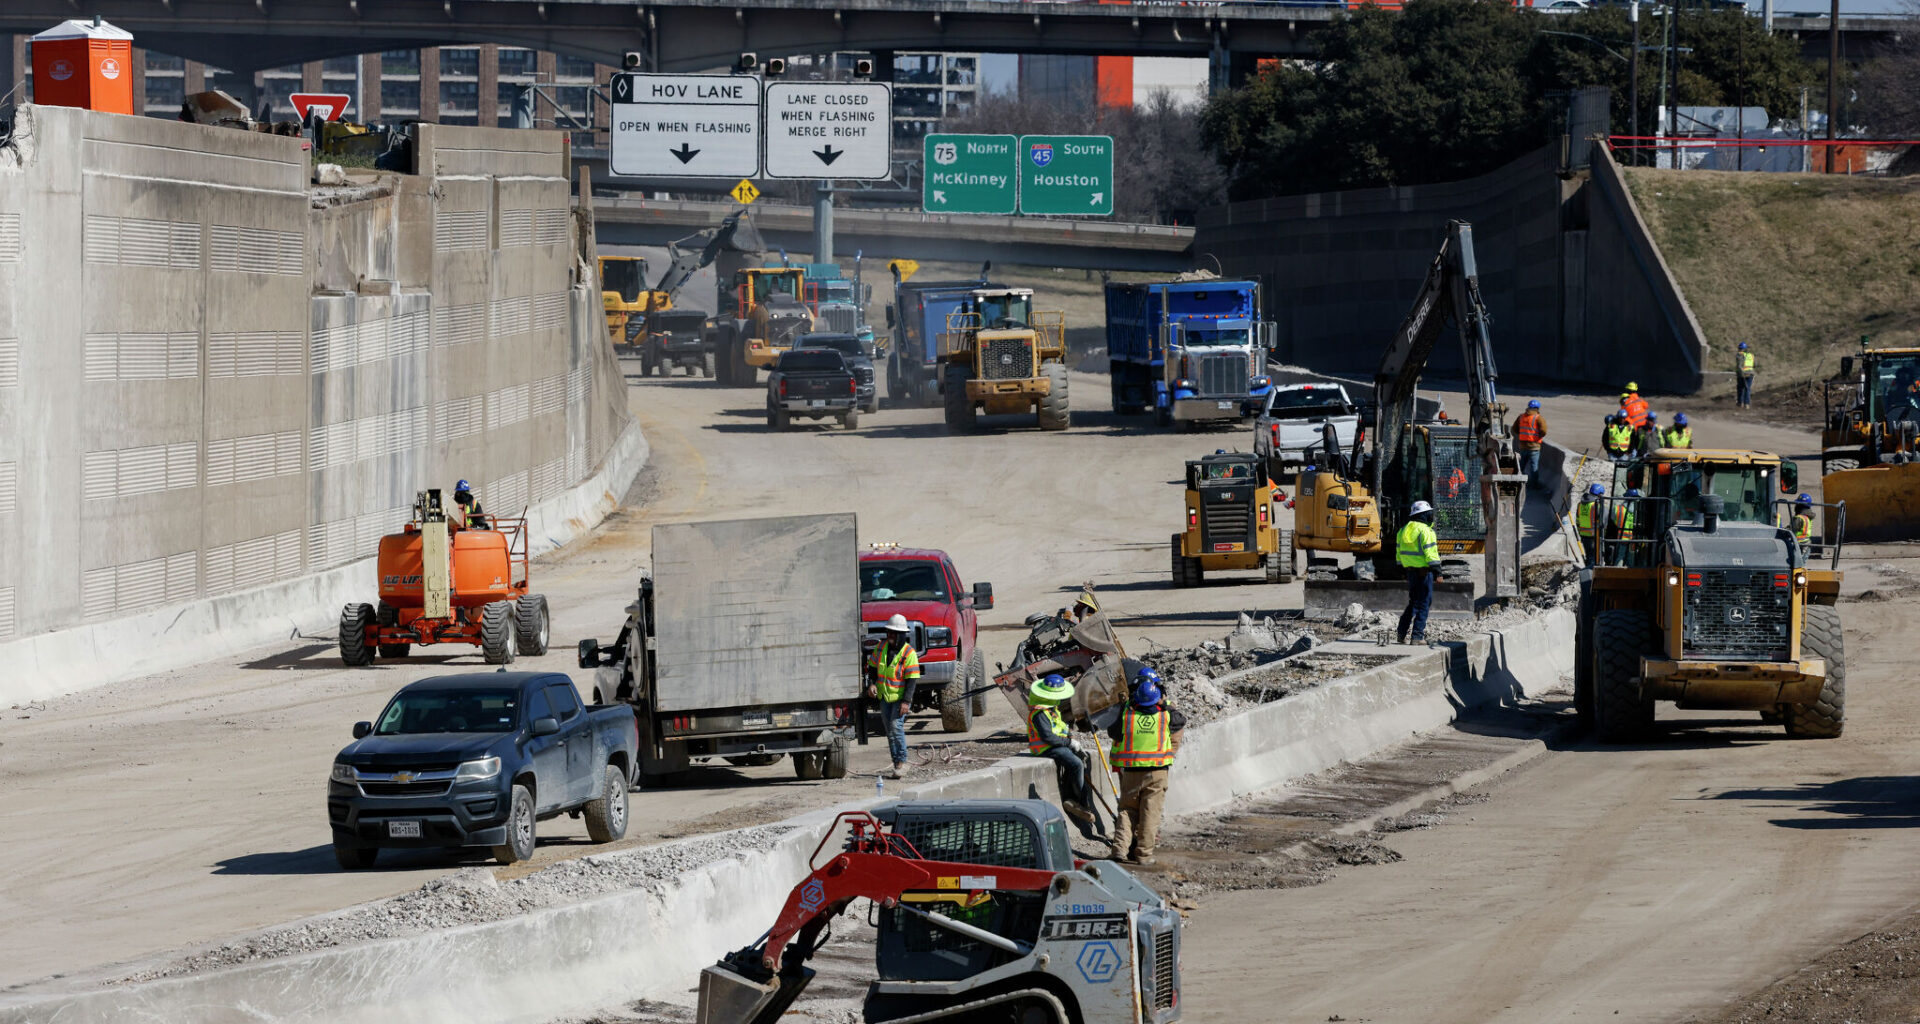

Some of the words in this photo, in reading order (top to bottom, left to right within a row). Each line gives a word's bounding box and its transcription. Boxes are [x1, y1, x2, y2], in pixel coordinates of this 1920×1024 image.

[652, 84, 688, 98] HOV
[697, 85, 743, 99] LANE
[787, 95, 817, 105] LANE
[824, 95, 868, 105] CLOSED
[781, 111, 812, 121] WHEN
[819, 111, 875, 122] FLASHING
[619, 121, 650, 132] OPEN
[657, 122, 688, 133] WHEN
[696, 122, 751, 133] FLASHING
[788, 127, 826, 137] MERGE
[834, 127, 867, 137] RIGHT
[936, 147, 954, 161] 75
[1033, 150, 1051, 162] 45
[933, 172, 1007, 188] McKinney
[1034, 174, 1099, 186] Houston
[1407, 297, 1430, 344] DEERE
